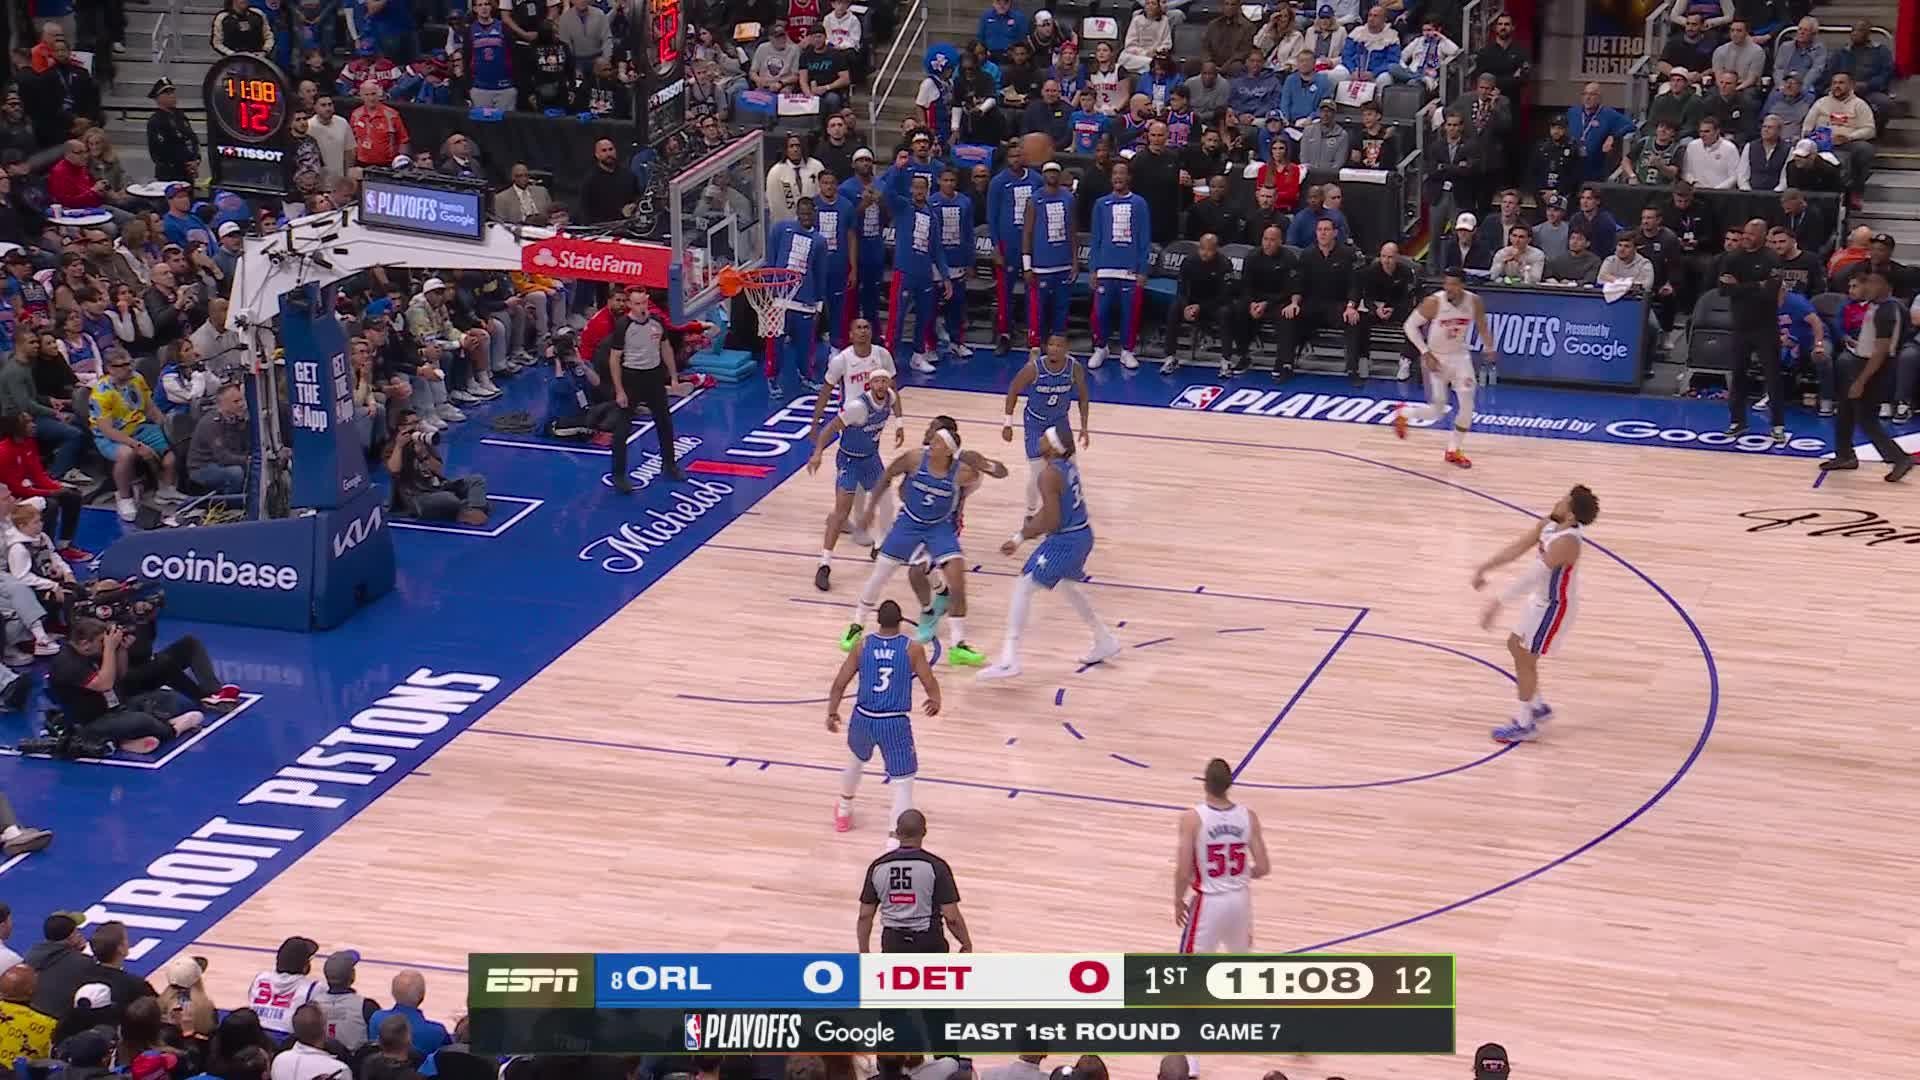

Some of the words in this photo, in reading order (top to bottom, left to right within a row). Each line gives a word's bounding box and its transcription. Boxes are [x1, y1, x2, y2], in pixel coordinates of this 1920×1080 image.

[226, 79, 276, 103] 11:08
[240, 102, 271, 132] 12
[377, 191, 437, 221] PLAYOFFS
[1563, 337, 1628, 361] Google
[294, 361, 319, 383] GET
[296, 383, 321, 405] THE
[578, 478, 733, 573] Michelob
[141, 549, 298, 590] coinbase
[873, 667, 893, 692] 3
[77, 816, 304, 961] TROIT
[237, 667, 501, 809] PISTONS
[1206, 843, 1247, 877] 55
[890, 867, 913, 890] 25
